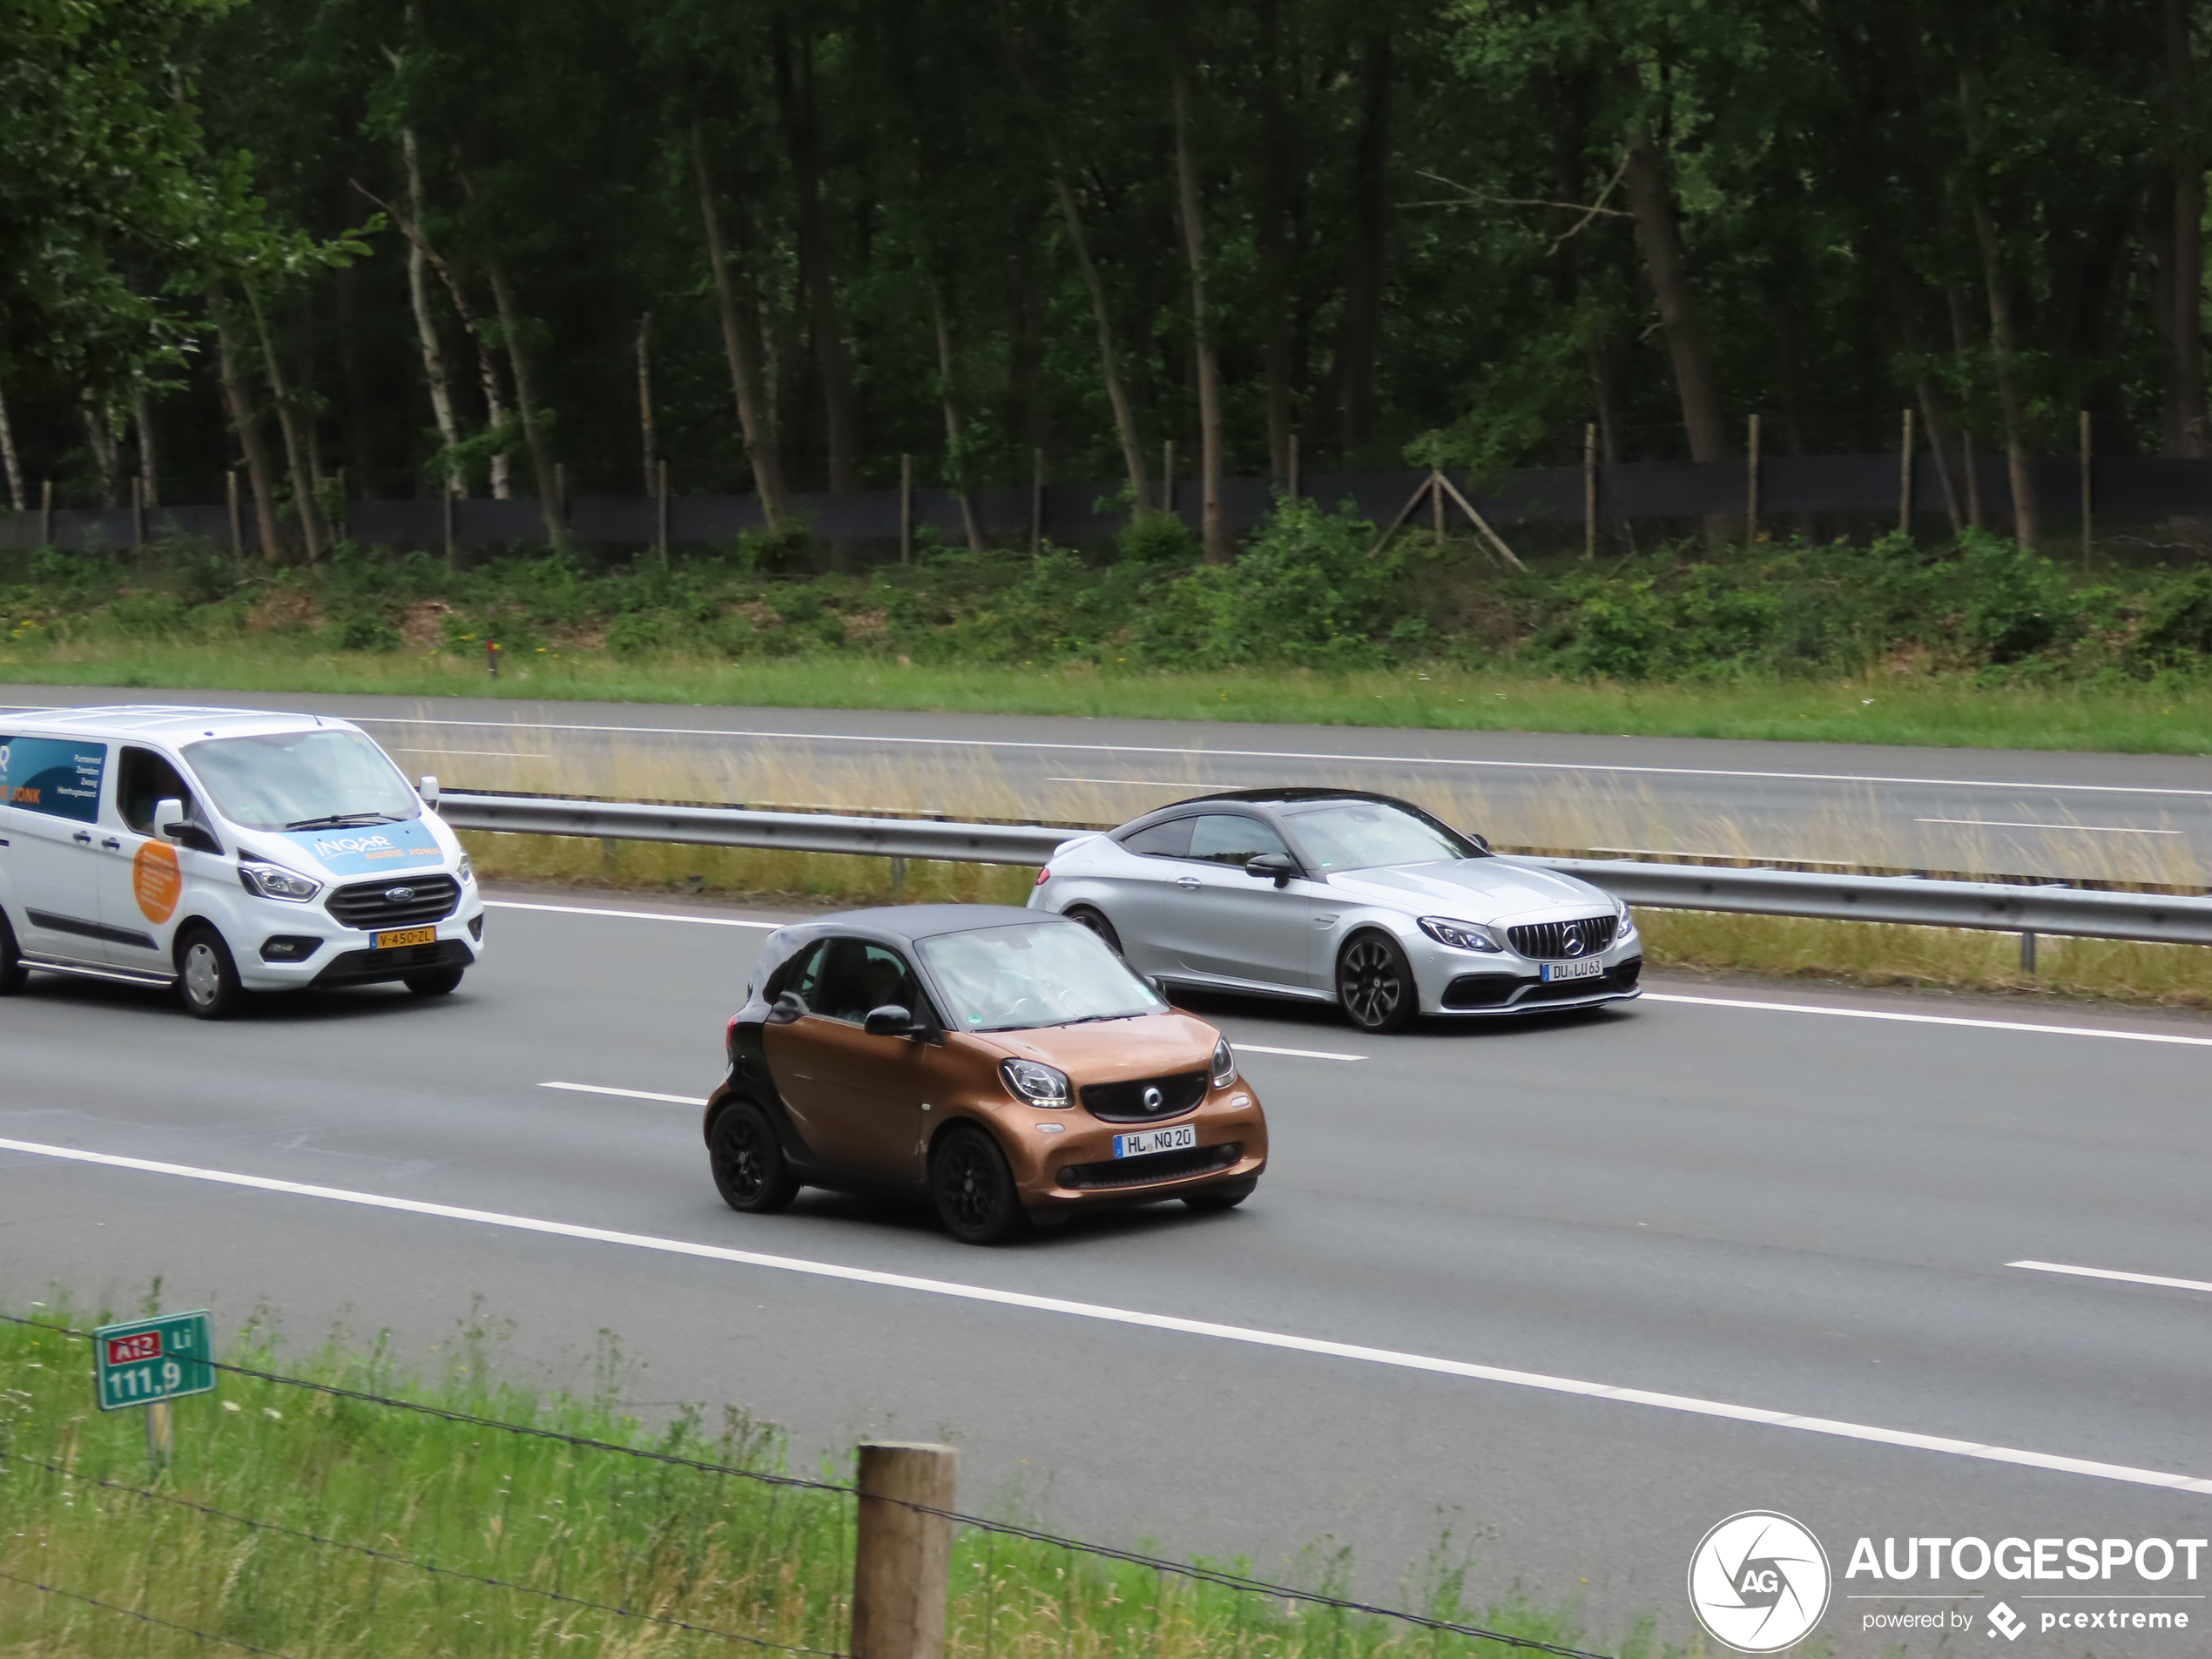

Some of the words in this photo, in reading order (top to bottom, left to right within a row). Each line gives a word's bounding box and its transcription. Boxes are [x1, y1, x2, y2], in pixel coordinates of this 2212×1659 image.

[11, 786, 41, 804] JONK
[366, 849, 405, 860] ADRIE
[408, 847, 442, 856] JONK
[380, 930, 430, 946] V-450-ZL
[1554, 964, 1568, 979] DU
[1575, 962, 1588, 976] LU
[1589, 961, 1600, 974] 63
[1128, 1136, 1146, 1154] HL
[1154, 1131, 1172, 1150] NQ
[1175, 1129, 1191, 1147] 20
[116, 1336, 154, 1360] A12
[172, 1329, 191, 1350] Li
